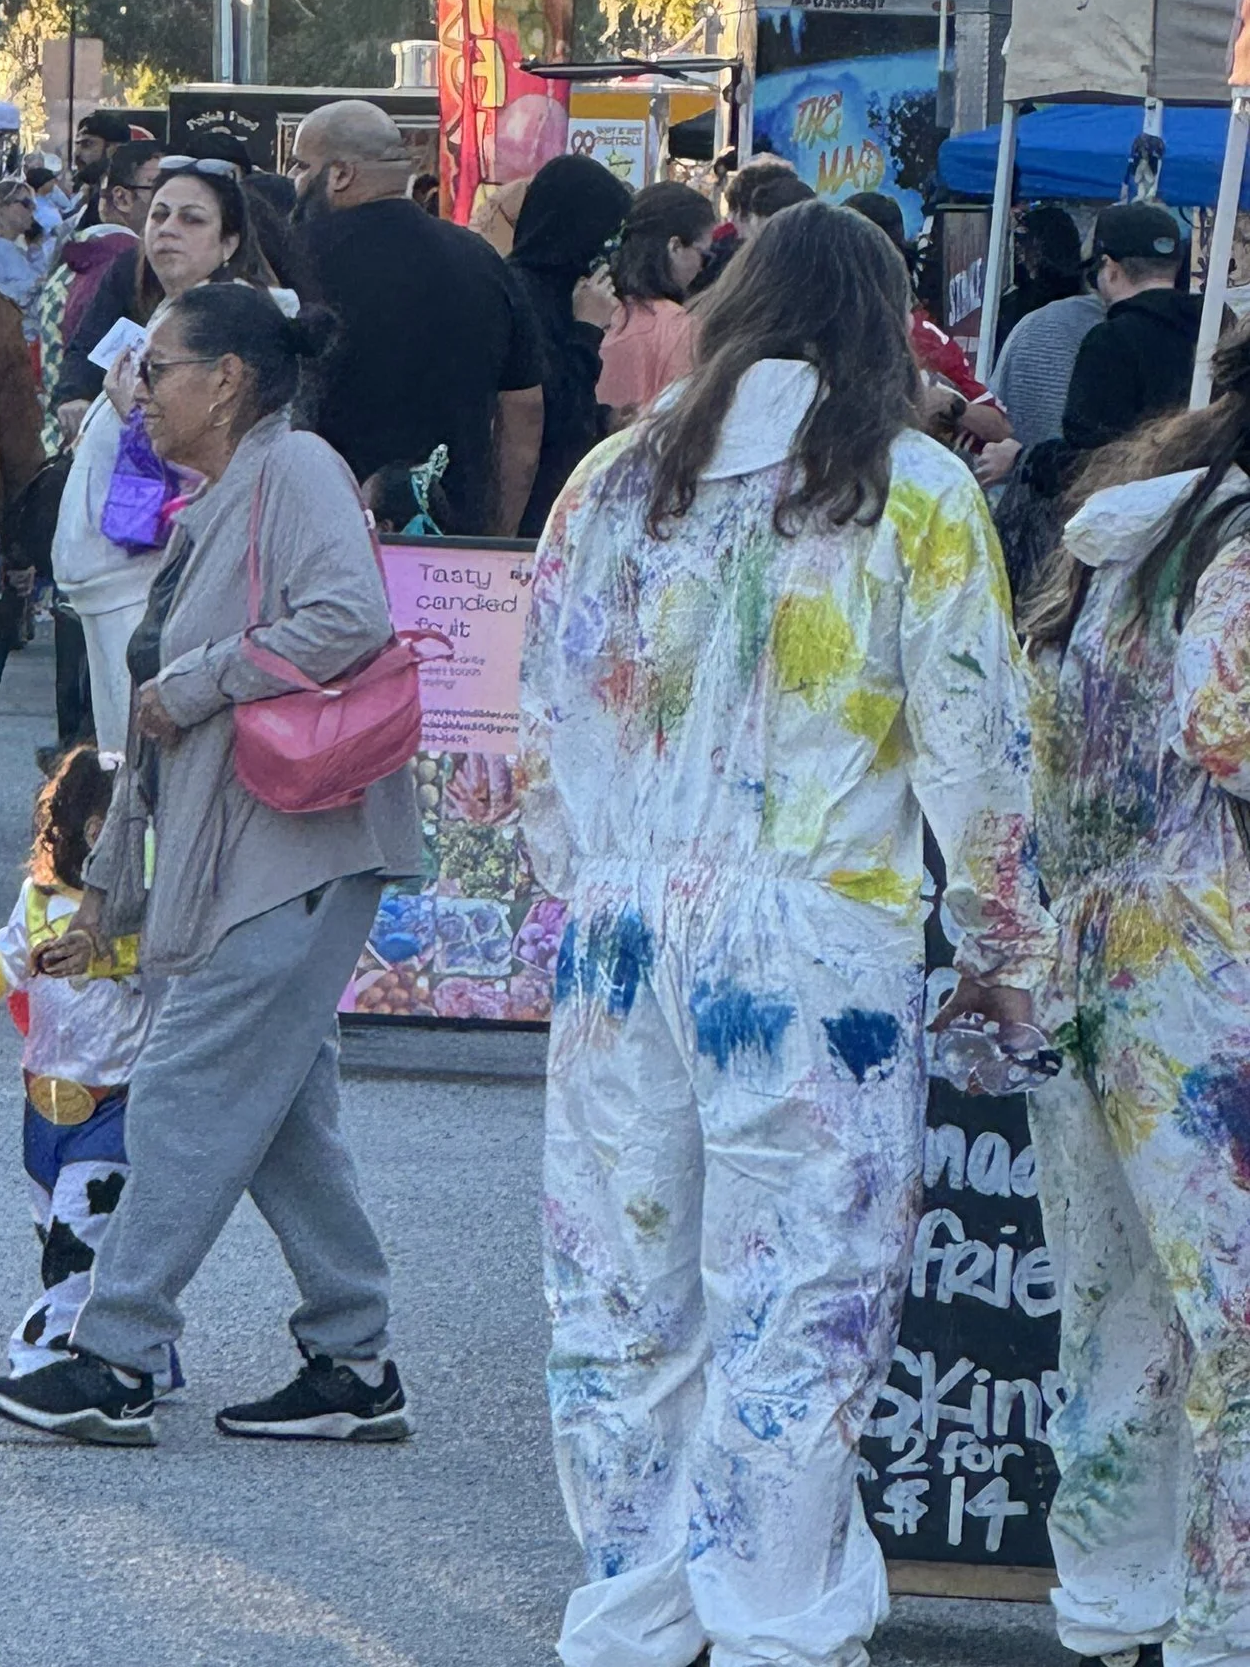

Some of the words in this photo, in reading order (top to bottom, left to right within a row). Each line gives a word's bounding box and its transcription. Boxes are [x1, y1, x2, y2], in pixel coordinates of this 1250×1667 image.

[816, 138, 885, 194] MAD
[418, 563, 491, 590] Tasty
[416, 594, 518, 613] candied
[885, 1428, 931, 1474] 2
[937, 1430, 1025, 1475] for
[873, 1476, 1029, 1552] $14
